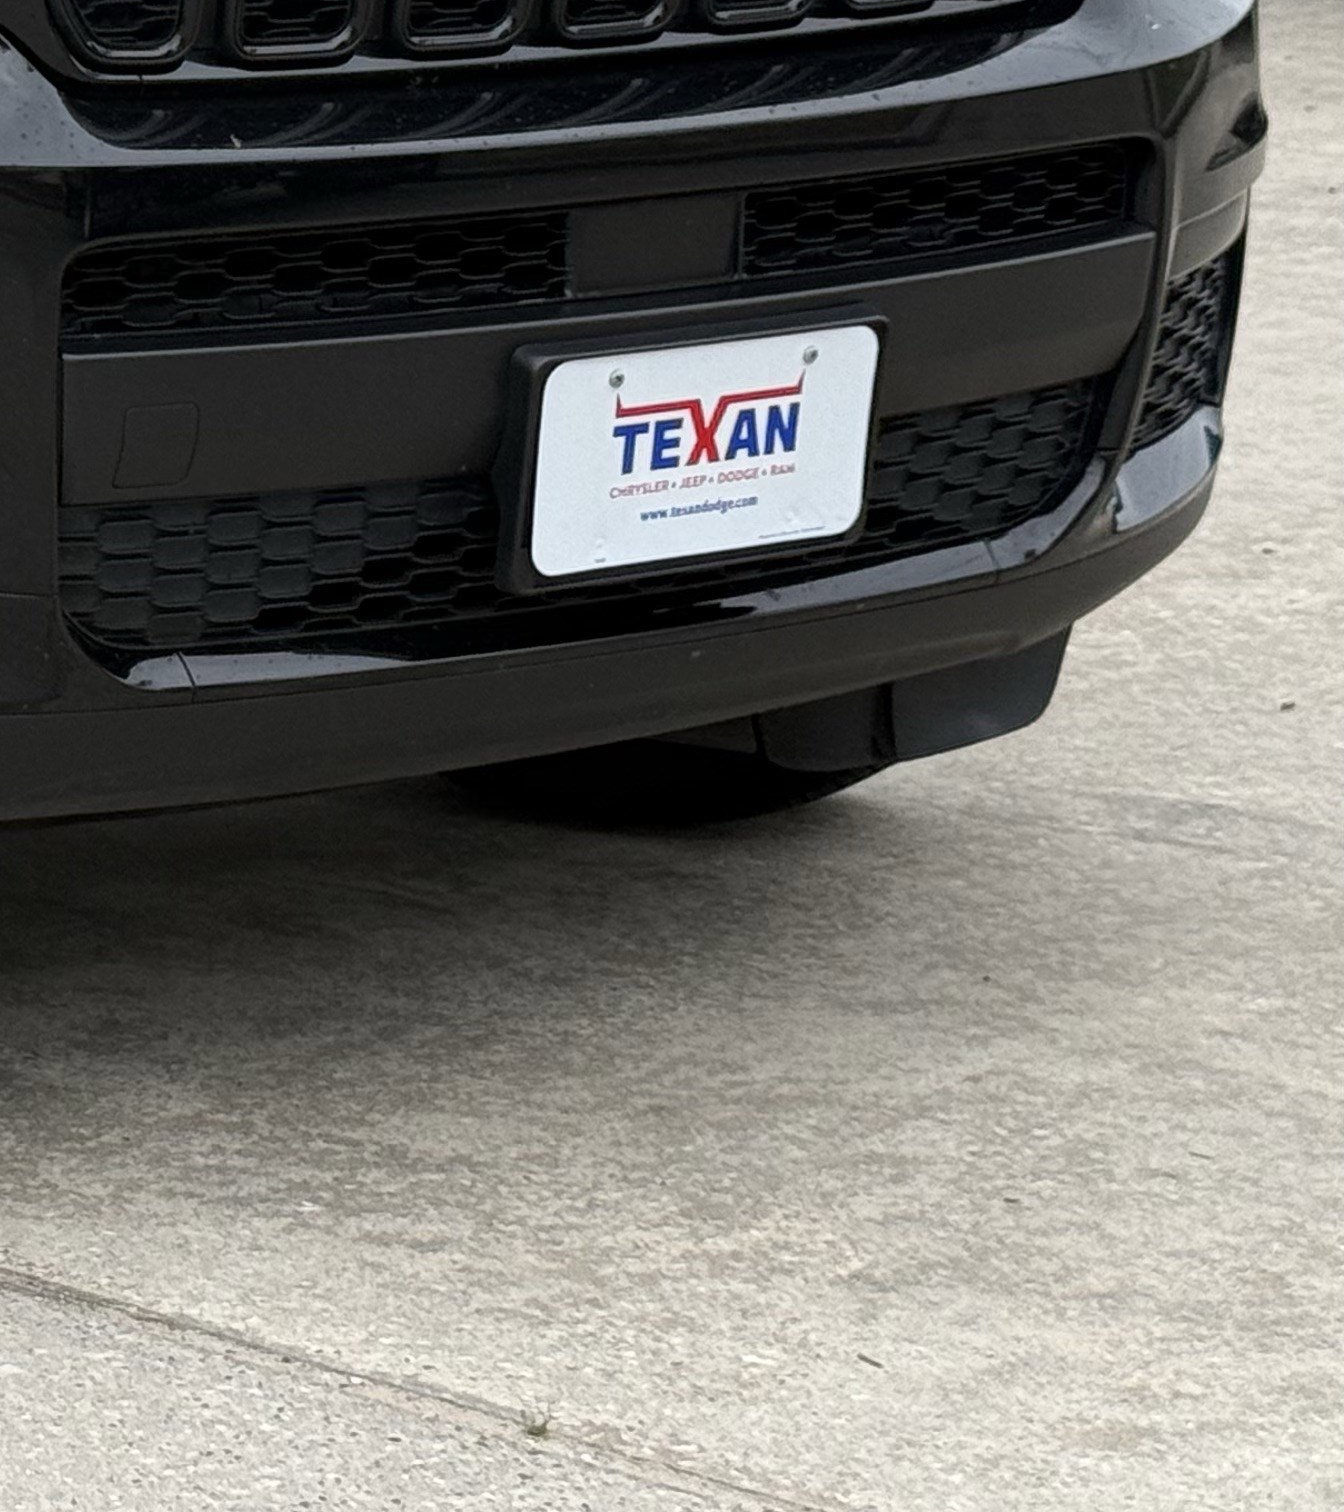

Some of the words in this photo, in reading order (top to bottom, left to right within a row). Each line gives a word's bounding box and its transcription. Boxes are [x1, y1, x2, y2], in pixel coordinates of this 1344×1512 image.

[612, 393, 802, 476] TEXAN
[609, 479, 670, 499] CHRYSLER
[679, 475, 707, 490] JEEP
[717, 467, 760, 484] DODGE
[770, 463, 796, 476] RAM
